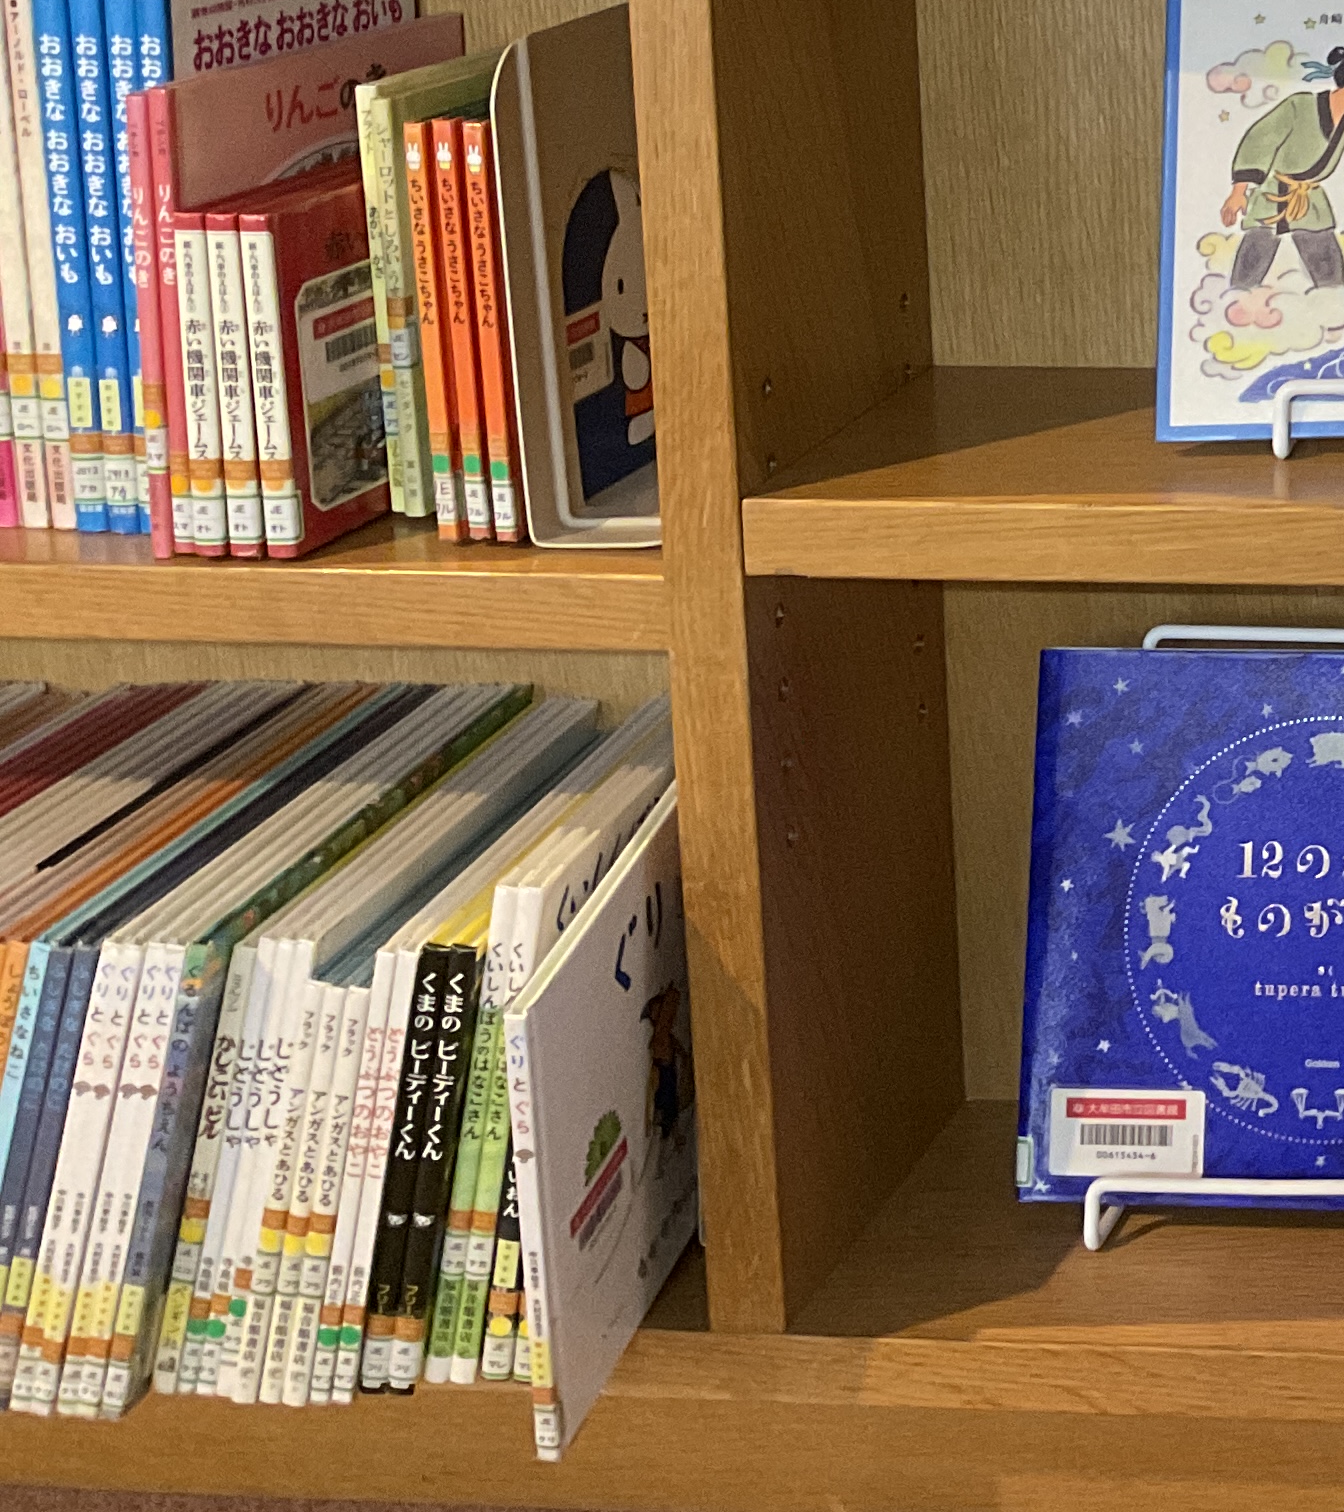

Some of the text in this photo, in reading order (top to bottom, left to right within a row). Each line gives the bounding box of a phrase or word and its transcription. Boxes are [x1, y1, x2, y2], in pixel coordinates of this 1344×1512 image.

[193, 14, 273, 72] おおきな
[39, 34, 79, 284] おおきな おおきな おいも
[75, 34, 114, 286] おおきな おおきな おいも
[394, 972, 439, 1162] くまの ビーティーくん
[421, 972, 466, 1162] くまの ビーティーくん
[509, 1034, 531, 1136] ぐりとぐら
[1254, 981, 1322, 1000] tupera
